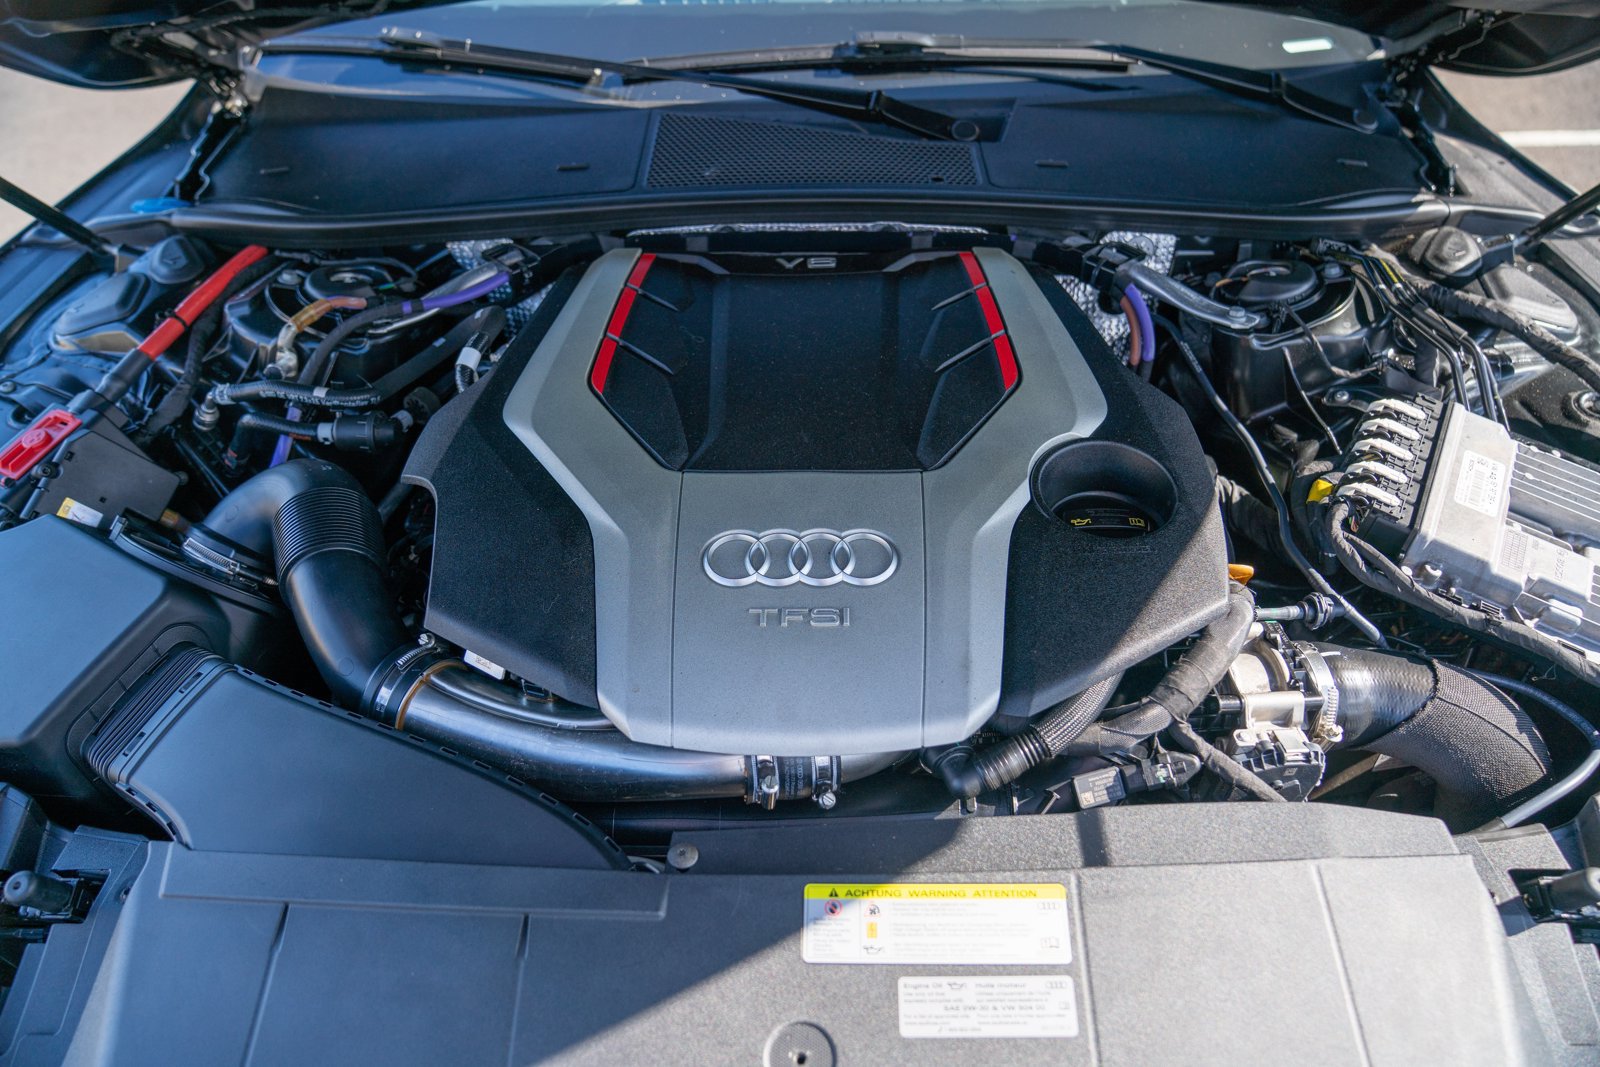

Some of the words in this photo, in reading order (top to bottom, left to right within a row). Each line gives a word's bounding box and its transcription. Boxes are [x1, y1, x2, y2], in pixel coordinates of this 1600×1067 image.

[776, 257, 837, 269] V6
[748, 607, 850, 627] TFSI
[845, 889, 902, 898] ACHTUNG
[908, 889, 966, 898] WARNING
[973, 889, 1038, 898] ATTENTION
